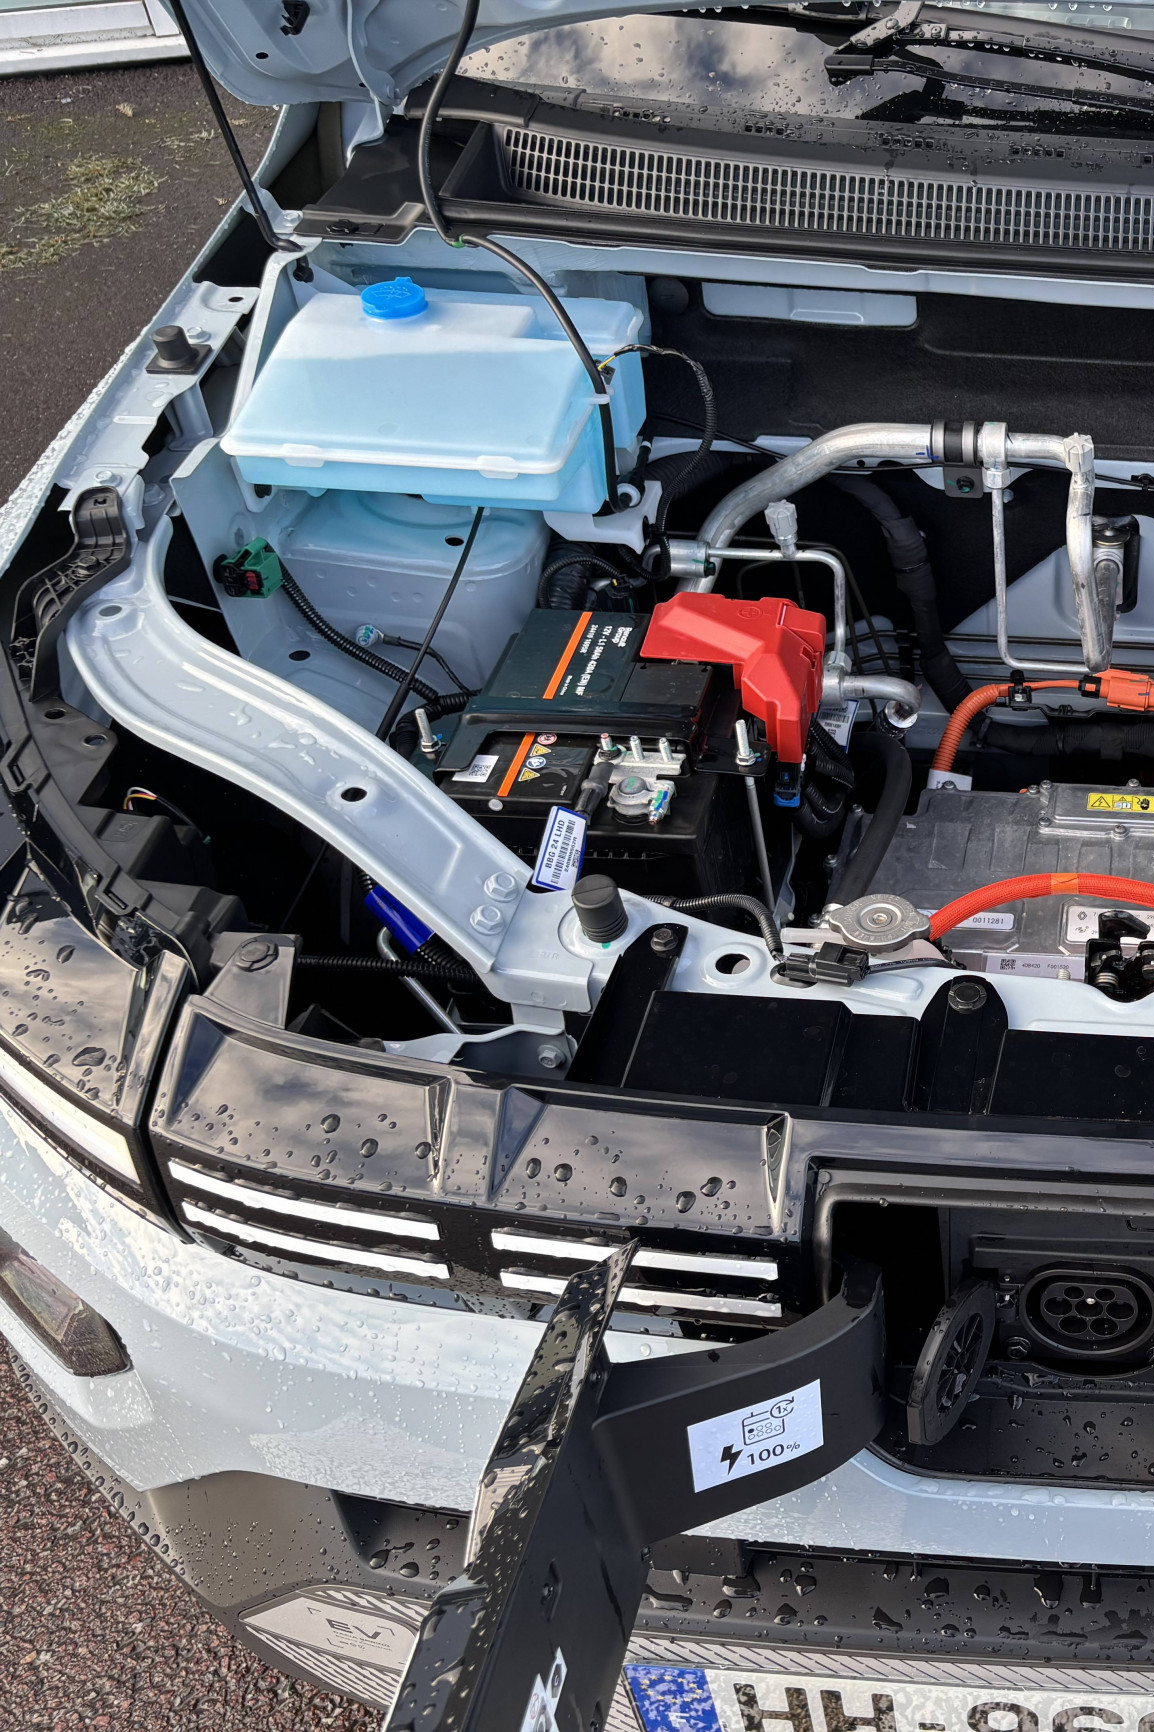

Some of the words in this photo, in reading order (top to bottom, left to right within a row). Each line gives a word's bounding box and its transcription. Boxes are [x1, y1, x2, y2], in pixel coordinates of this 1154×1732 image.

[602, 626, 613, 636] 12V
[611, 626, 626, 644] Group
[617, 627, 633, 648] Renault
[554, 820, 565, 838] LHD
[551, 839, 559, 850] 24
[545, 851, 556, 869] BBG
[775, 1405, 788, 1415] 1x
[746, 1441, 801, 1465] 100%
[326, 1618, 381, 1639] EV
